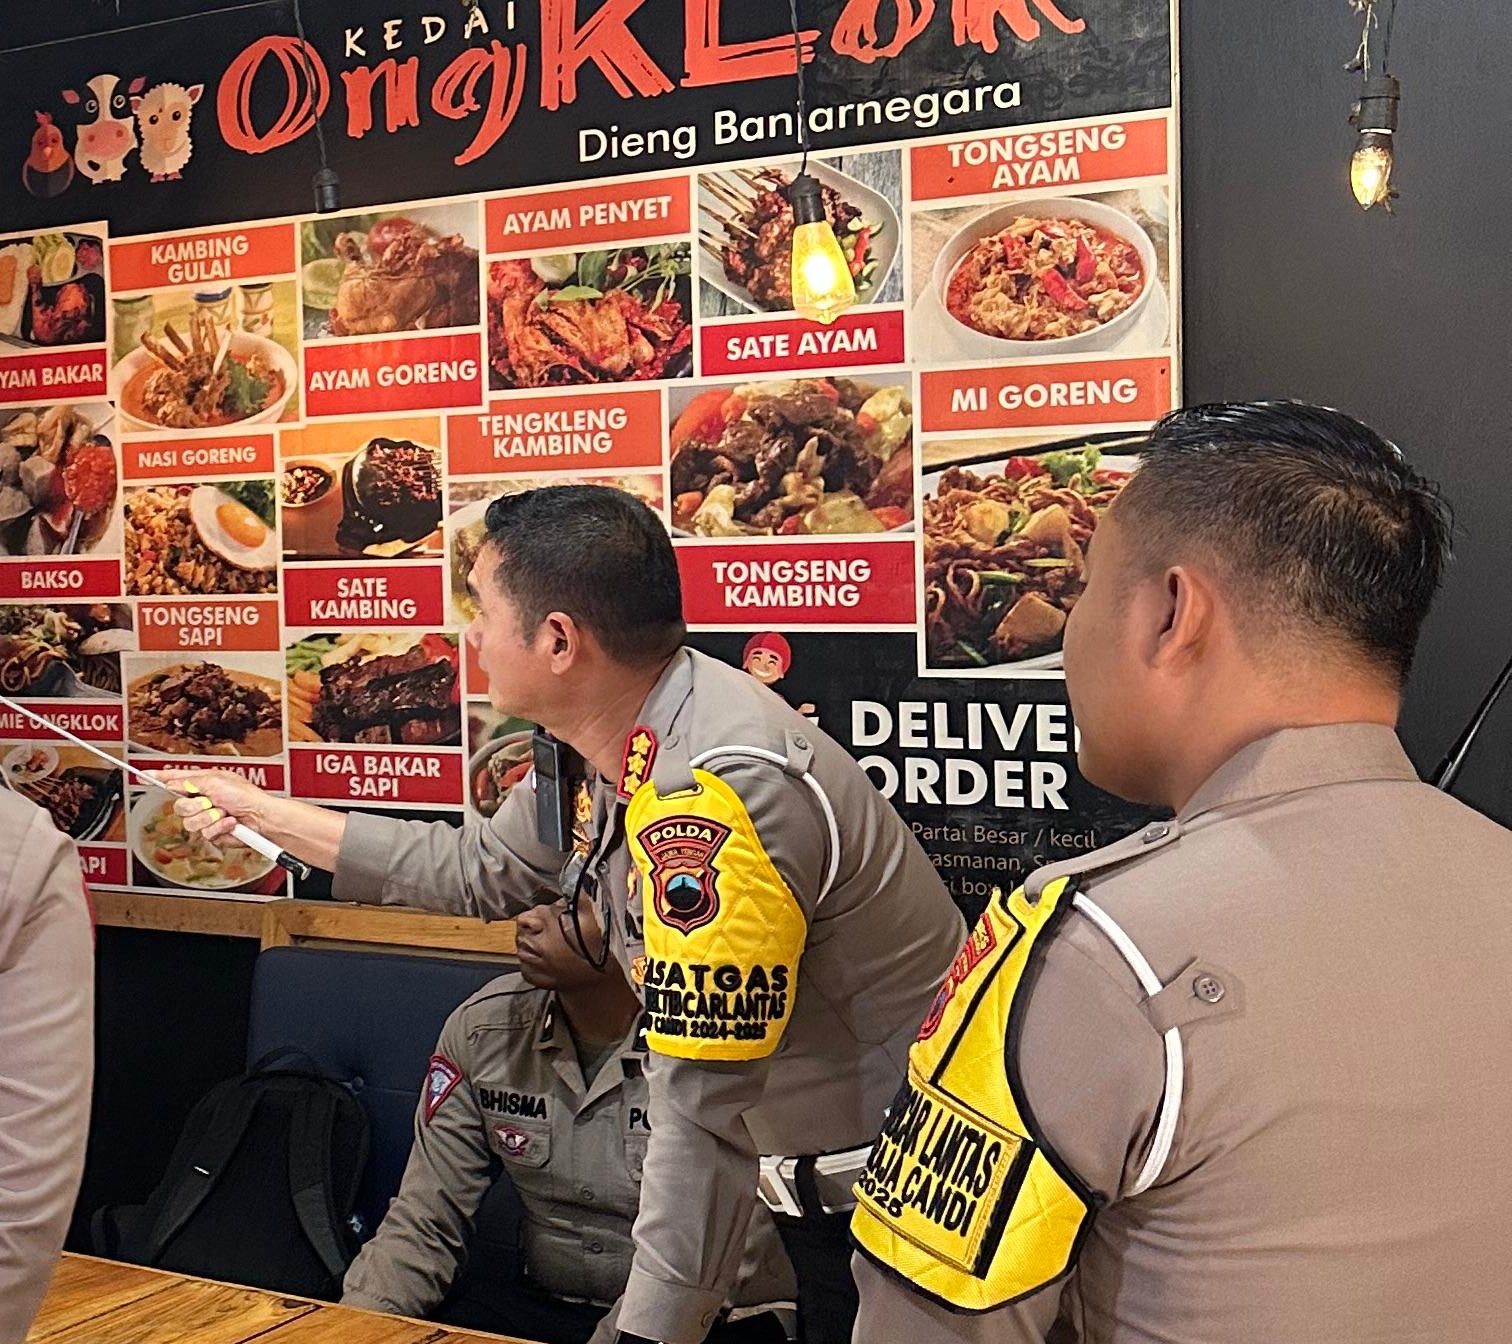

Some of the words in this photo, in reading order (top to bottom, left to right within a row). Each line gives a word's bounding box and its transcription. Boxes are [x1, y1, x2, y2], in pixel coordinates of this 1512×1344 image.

[344, 0, 517, 58] KEDAI
[578, 123, 698, 164] Dieng
[713, 81, 1023, 146] Banjarnegara
[949, 125, 1127, 168] TONGSENG
[991, 160, 1080, 189] AYAM
[502, 207, 574, 236] AYAM
[579, 195, 672, 226] PENYET
[151, 235, 249, 266] KAMBING
[167, 260, 232, 283] GULAI
[726, 333, 794, 362] SATE
[798, 325, 878, 355] AYAM
[40, 363, 103, 387] BAKAR
[308, 369, 374, 392] AYAM
[375, 359, 478, 388] GORENG
[951, 384, 987, 413] MI
[999, 378, 1138, 411] GORENG
[478, 408, 628, 438] TENGKLENG
[138, 450, 178, 468] NASI
[180, 445, 257, 466] GORENG
[492, 430, 613, 459] KAMBING
[20, 569, 84, 590] BAKSO
[711, 558, 872, 586] TONGSENG
[336, 577, 388, 599] SATE
[723, 582, 861, 609] KAMBING
[141, 606, 260, 628] TONGSENG
[309, 597, 418, 620] KAMBING
[177, 627, 223, 648] SAPI
[28, 713, 120, 732] ONGKLOK
[850, 699, 1080, 754] DELIVE
[315, 754, 360, 776] IGA
[363, 758, 442, 779] BAKAR
[348, 778, 400, 799] SAPI
[856, 757, 1070, 811] ORDER
[650, 824, 712, 845] POLDA
[912, 822, 967, 843] Partai
[974, 826, 1029, 846] Besar
[1034, 829, 1044, 848] /
[1050, 827, 1097, 849] kecil
[930, 852, 1026, 874] asmanan,
[479, 1087, 548, 1120] BHISMA
[918, 1108, 1002, 1200] LANTAS
[901, 1165, 978, 1238] CANDI
